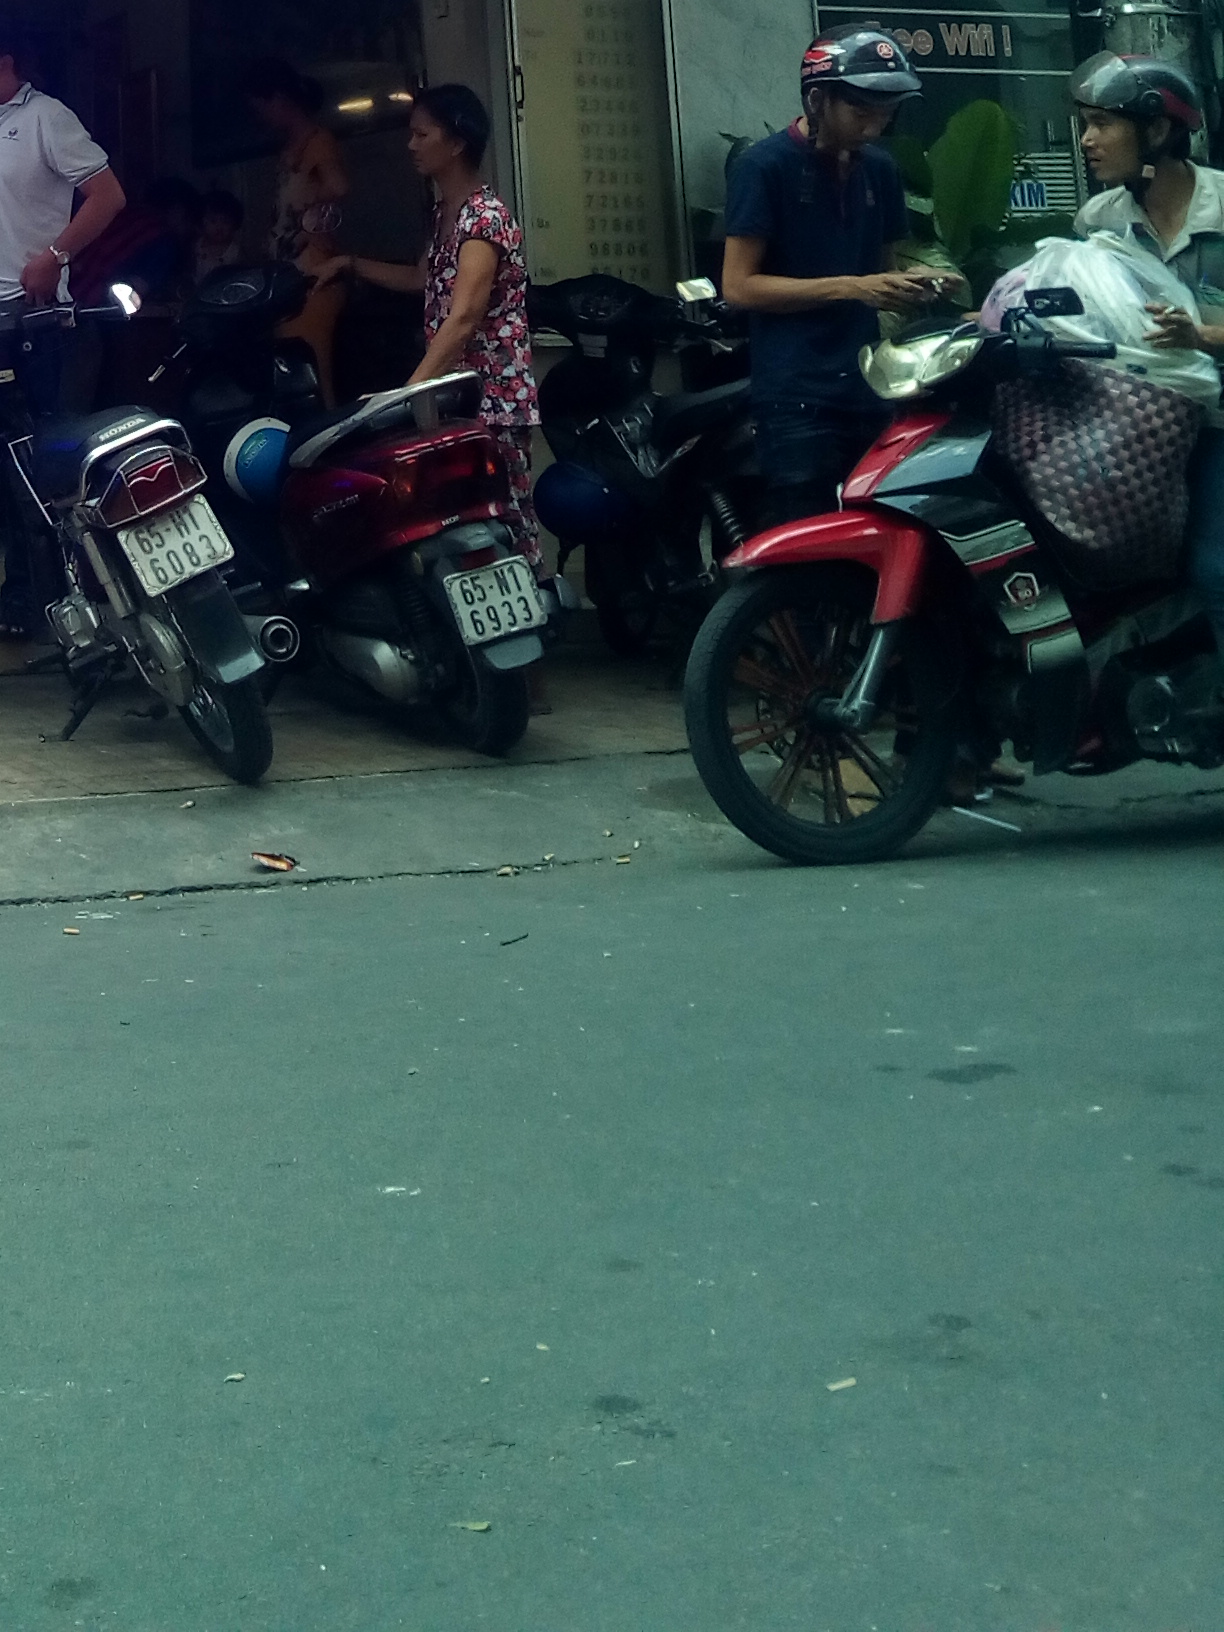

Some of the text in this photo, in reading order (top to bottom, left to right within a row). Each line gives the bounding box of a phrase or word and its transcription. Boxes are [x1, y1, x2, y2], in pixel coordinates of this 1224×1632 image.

[939, 21, 997, 57] Wifi
[98, 416, 147, 442] HONDA
[150, 534, 217, 585] 6083
[469, 596, 533, 636] 6933
